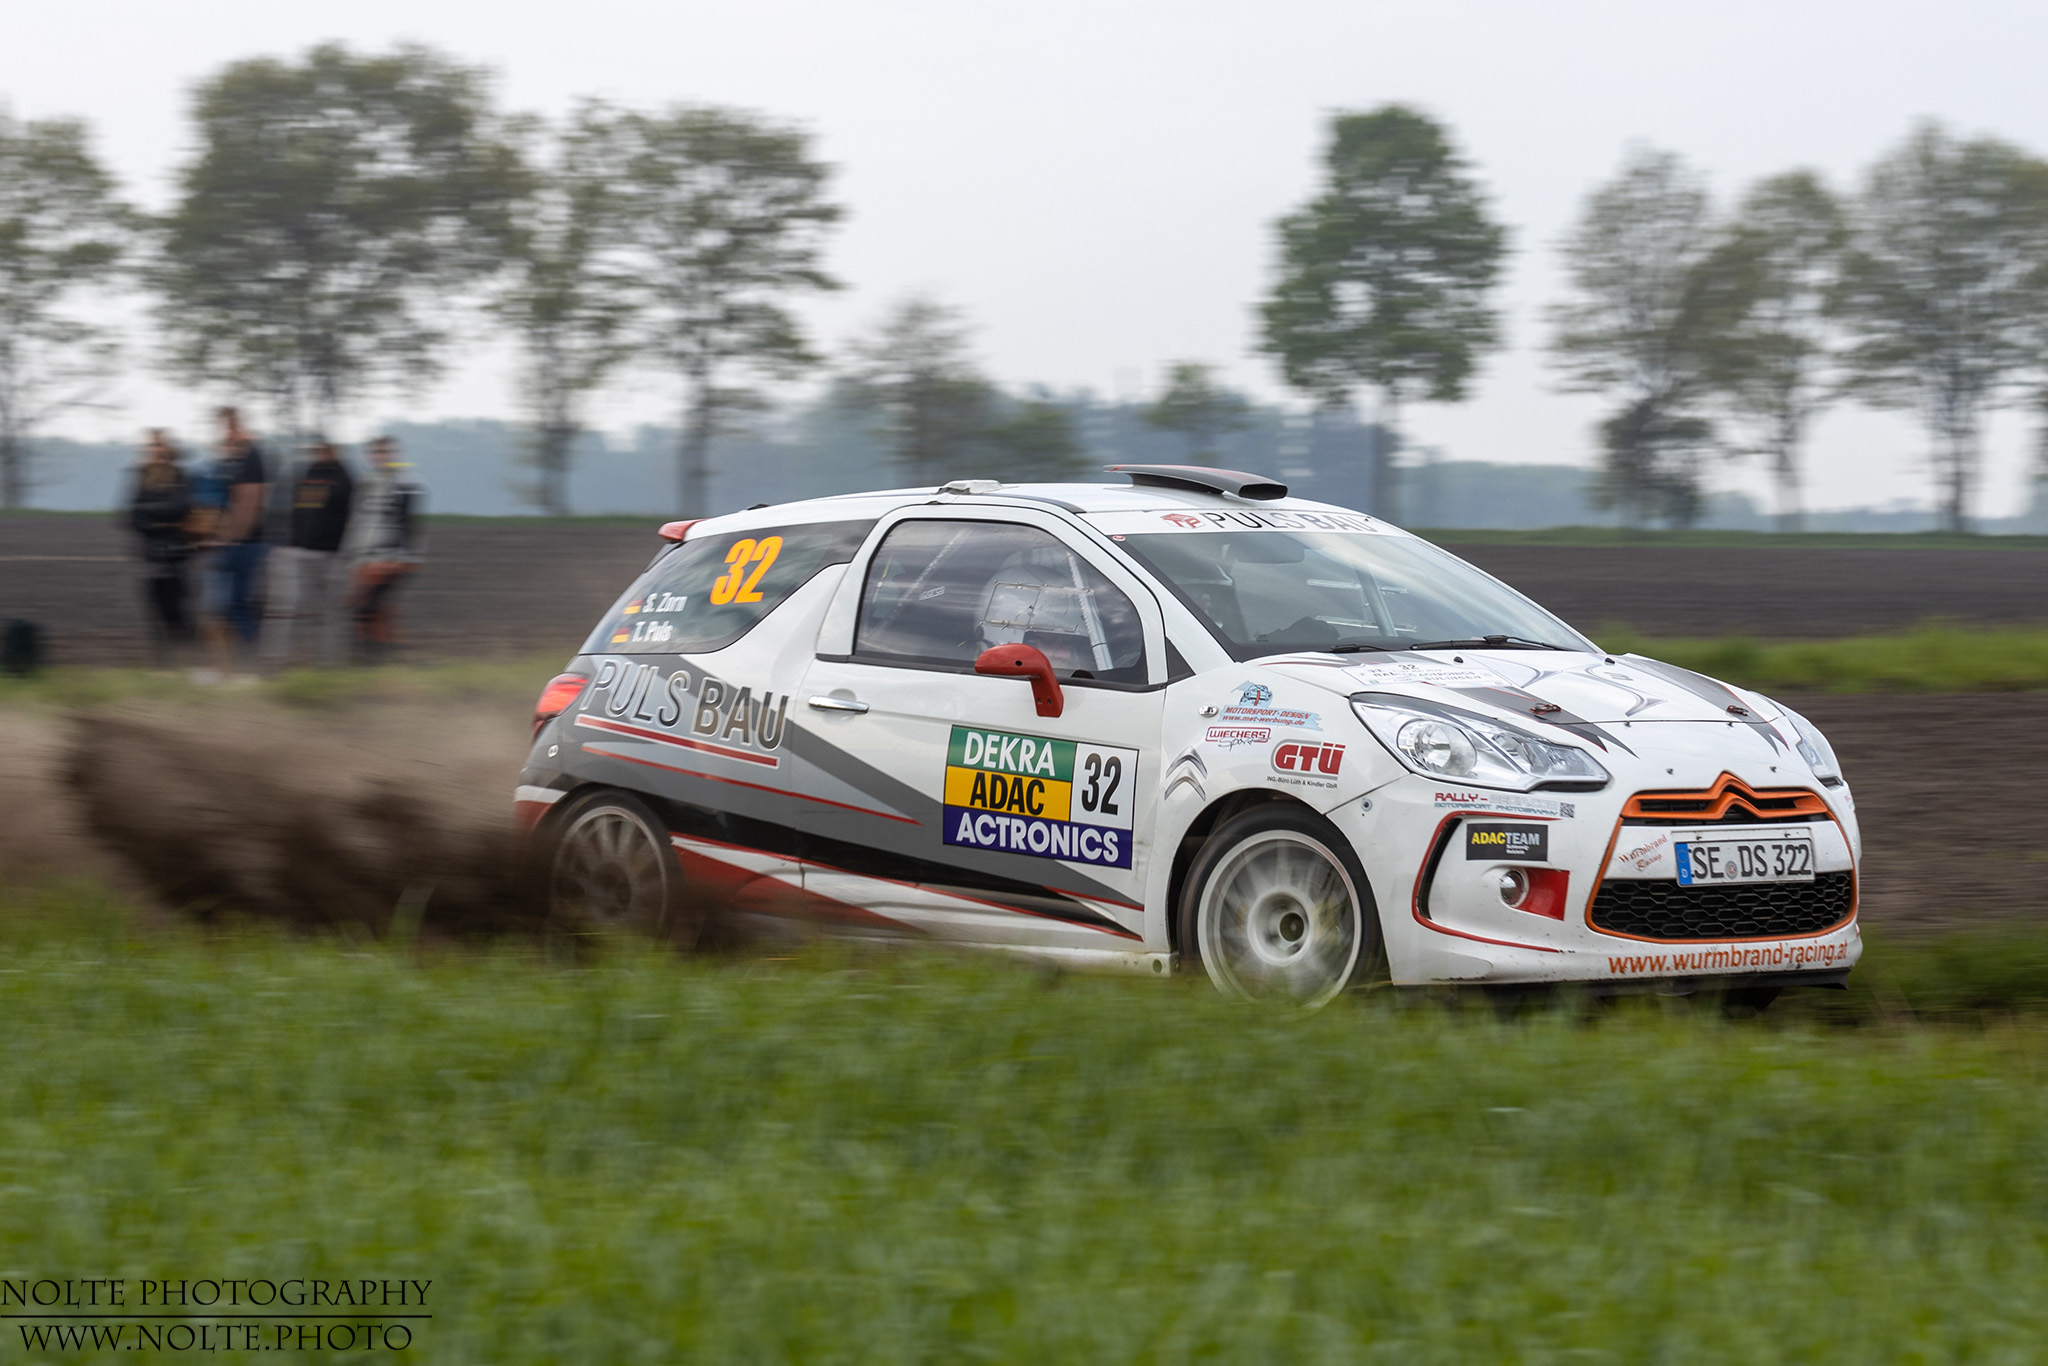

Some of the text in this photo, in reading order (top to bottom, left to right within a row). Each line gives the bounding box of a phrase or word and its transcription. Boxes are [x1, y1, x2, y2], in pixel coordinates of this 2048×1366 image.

[1201, 512, 1378, 532] PULS BAU
[709, 535, 784, 606] 32
[632, 620, 673, 642] T. Puls
[580, 658, 790, 752] PULS BAU
[1210, 730, 1267, 738] WIECHERS
[962, 732, 1056, 776] DEKRA
[1275, 742, 1346, 774] GTÜ
[969, 772, 1045, 816] ADAC
[1081, 753, 1122, 816] 32
[956, 812, 1119, 862] ACTRONICS
[1692, 846, 1724, 879] SE
[1738, 844, 1768, 878] DS
[1772, 844, 1812, 876] 322
[1608, 939, 1848, 974] www.wurmbrand-racing.at
